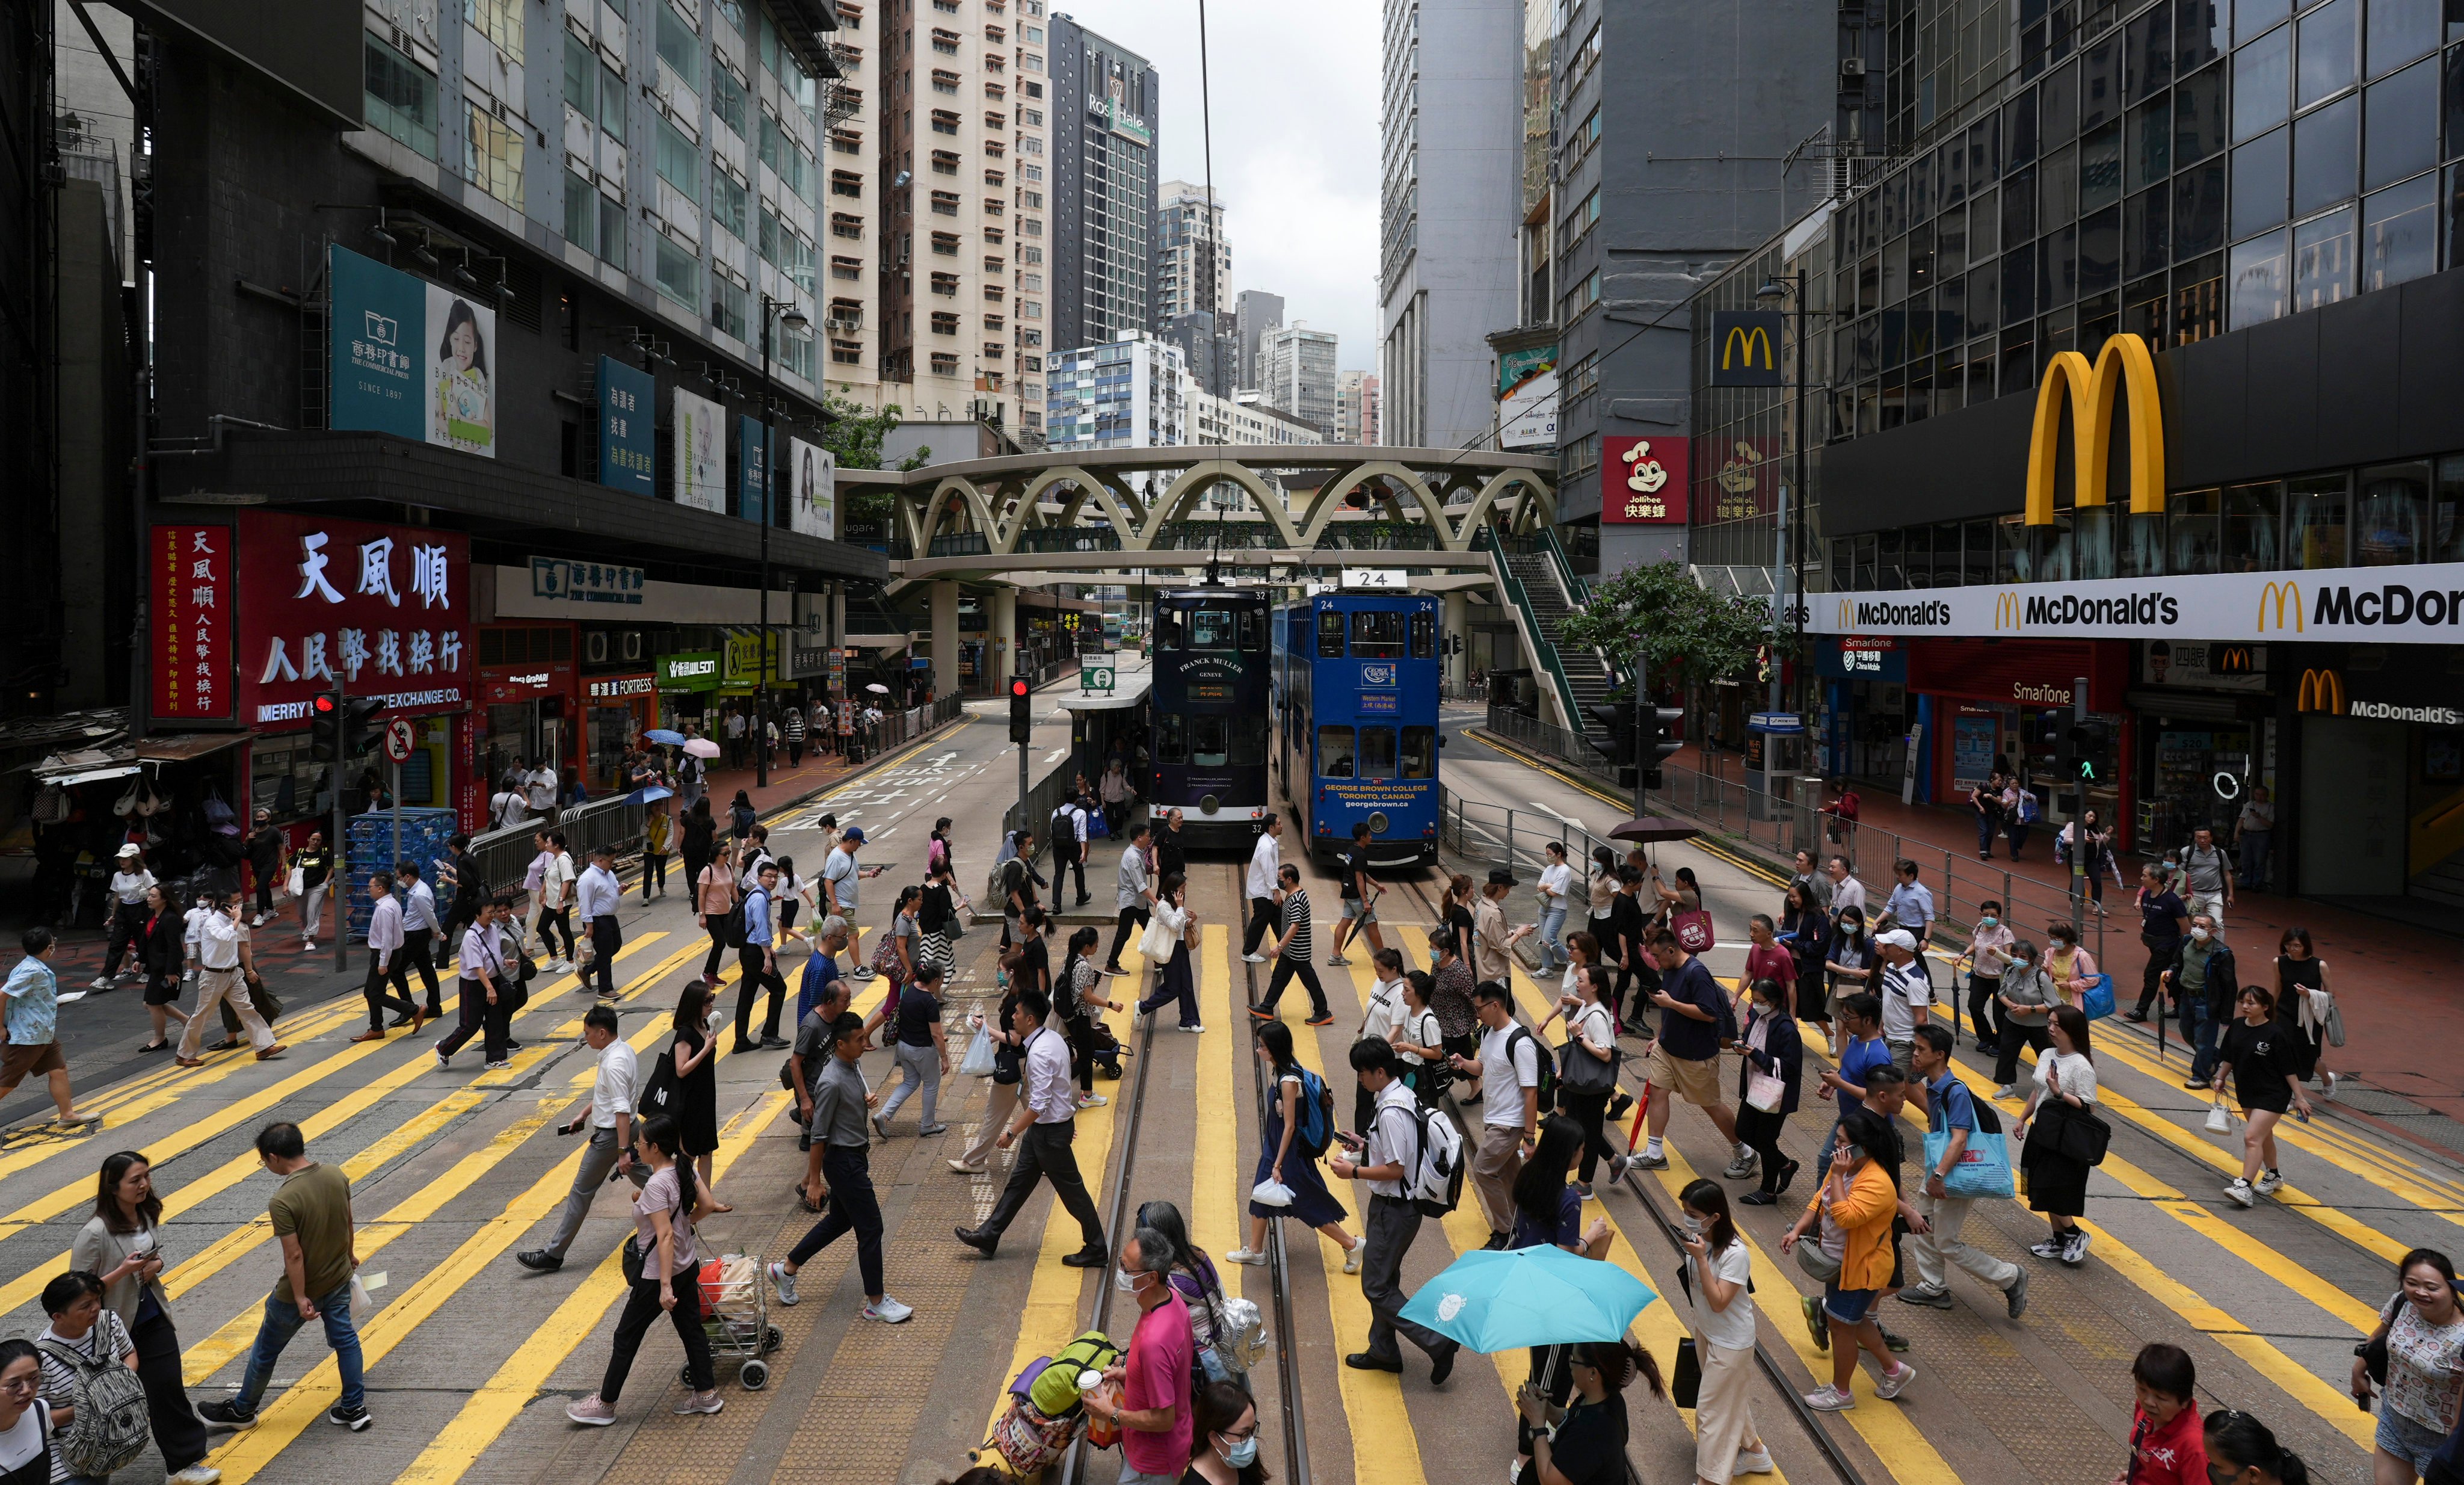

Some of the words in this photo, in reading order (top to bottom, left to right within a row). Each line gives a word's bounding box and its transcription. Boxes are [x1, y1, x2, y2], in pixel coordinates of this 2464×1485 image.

[1089, 93, 1144, 132] Rosdale
[351, 339, 410, 371] 商務印書館
[1507, 357, 1517, 369] 68
[351, 357, 362, 365] THE
[363, 360, 395, 375] COMMERCIAL
[395, 369, 409, 380] PRESS
[435, 367, 488, 394] BRIDGING
[359, 381, 381, 395] SINCE
[386, 389, 402, 400] 1897
[435, 387, 468, 407] BOOKS
[611, 386, 635, 412] 為讀者
[435, 410, 461, 424] WITH
[611, 416, 626, 438] 找書
[436, 428, 482, 449] READERS
[611, 445, 651, 474] 為書找讀者
[1630, 495, 1662, 504] Jollibee
[1624, 504, 1666, 519] 快樂蜂
[292, 531, 449, 610] 天風順
[1360, 572, 1387, 585] 24
[570, 590, 584, 600] THE
[1160, 590, 1170, 599] 32
[1255, 591, 1266, 600] 32
[1320, 600, 1334, 610] 24
[1420, 602, 1433, 611] 24
[1858, 600, 1950, 626] McDonald's
[2025, 592, 2178, 625] McDonald's
[192, 531, 215, 711] 天風順人民幣找換行
[1845, 638, 1892, 647] SmarTone
[259, 628, 463, 684] 人民幣找換行
[1856, 650, 1881, 662] 中國移動
[690, 660, 715, 675] WILSON
[1179, 657, 1210, 672] FRANCK
[1213, 657, 1243, 674] MULLER
[1856, 662, 1867, 670] China
[1867, 663, 1880, 671] Mobile
[526, 673, 549, 684] GraPARI
[620, 678, 651, 696] FORTRESS
[2013, 682, 2071, 703] SmarTone
[258, 701, 307, 723] MERRY
[389, 690, 444, 709] EXCHANGE
[446, 688, 462, 702] CO.
[2350, 700, 2457, 725] McDonald's
[881, 767, 952, 777] BUS
[1252, 824, 1262, 833] 32
[1423, 842, 1434, 852] 24
